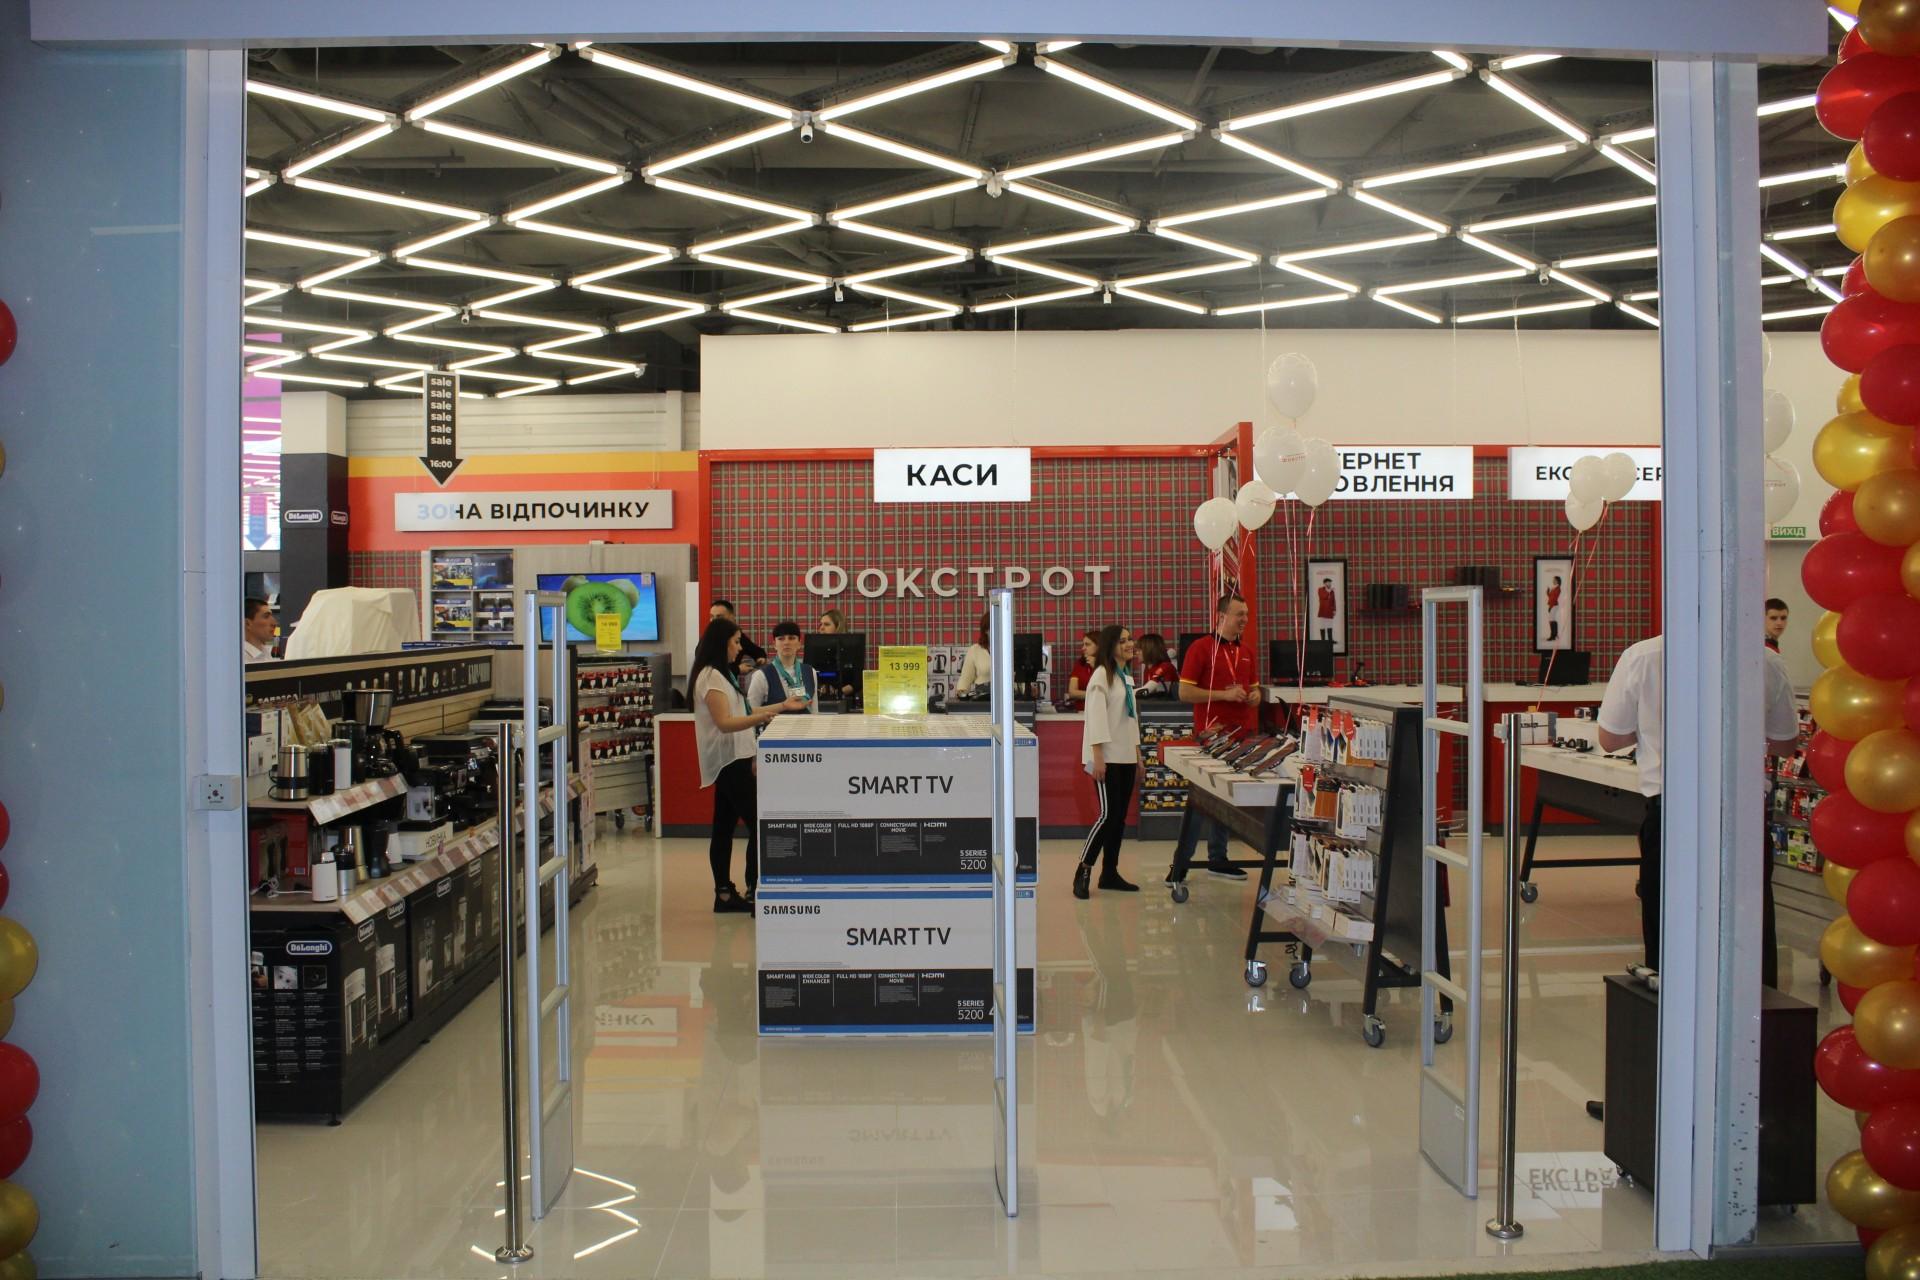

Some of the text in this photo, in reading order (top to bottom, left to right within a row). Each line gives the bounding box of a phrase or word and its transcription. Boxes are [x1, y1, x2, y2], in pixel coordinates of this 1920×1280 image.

[430, 377, 452, 386] sale
[430, 389, 452, 398] sale
[430, 401, 452, 410] sale
[430, 413, 452, 422] sale
[430, 424, 452, 433] sale
[430, 436, 452, 445] sale
[429, 460, 453, 468] 16:00
[1338, 452, 1421, 470] ЕРНЕТ
[907, 463, 998, 486] КАСИ
[1536, 466, 1573, 481] ЕКС
[1334, 475, 1454, 493] ОВЛЕННЯ
[417, 502, 650, 521] ЗОНА ВІДПОЧИНКУ
[1772, 527, 1805, 537] ВИХІД
[805, 562, 1110, 598] ФОКСТРОТ
[890, 662, 920, 671] 13 999
[765, 753, 822, 763] SAMSUNG
[848, 776, 954, 794] SMART TV
[960, 859, 987, 870] 5200
[763, 905, 821, 915] SAMSUNG
[846, 927, 951, 946] SMART TV
[957, 1009, 984, 1020] 5200
